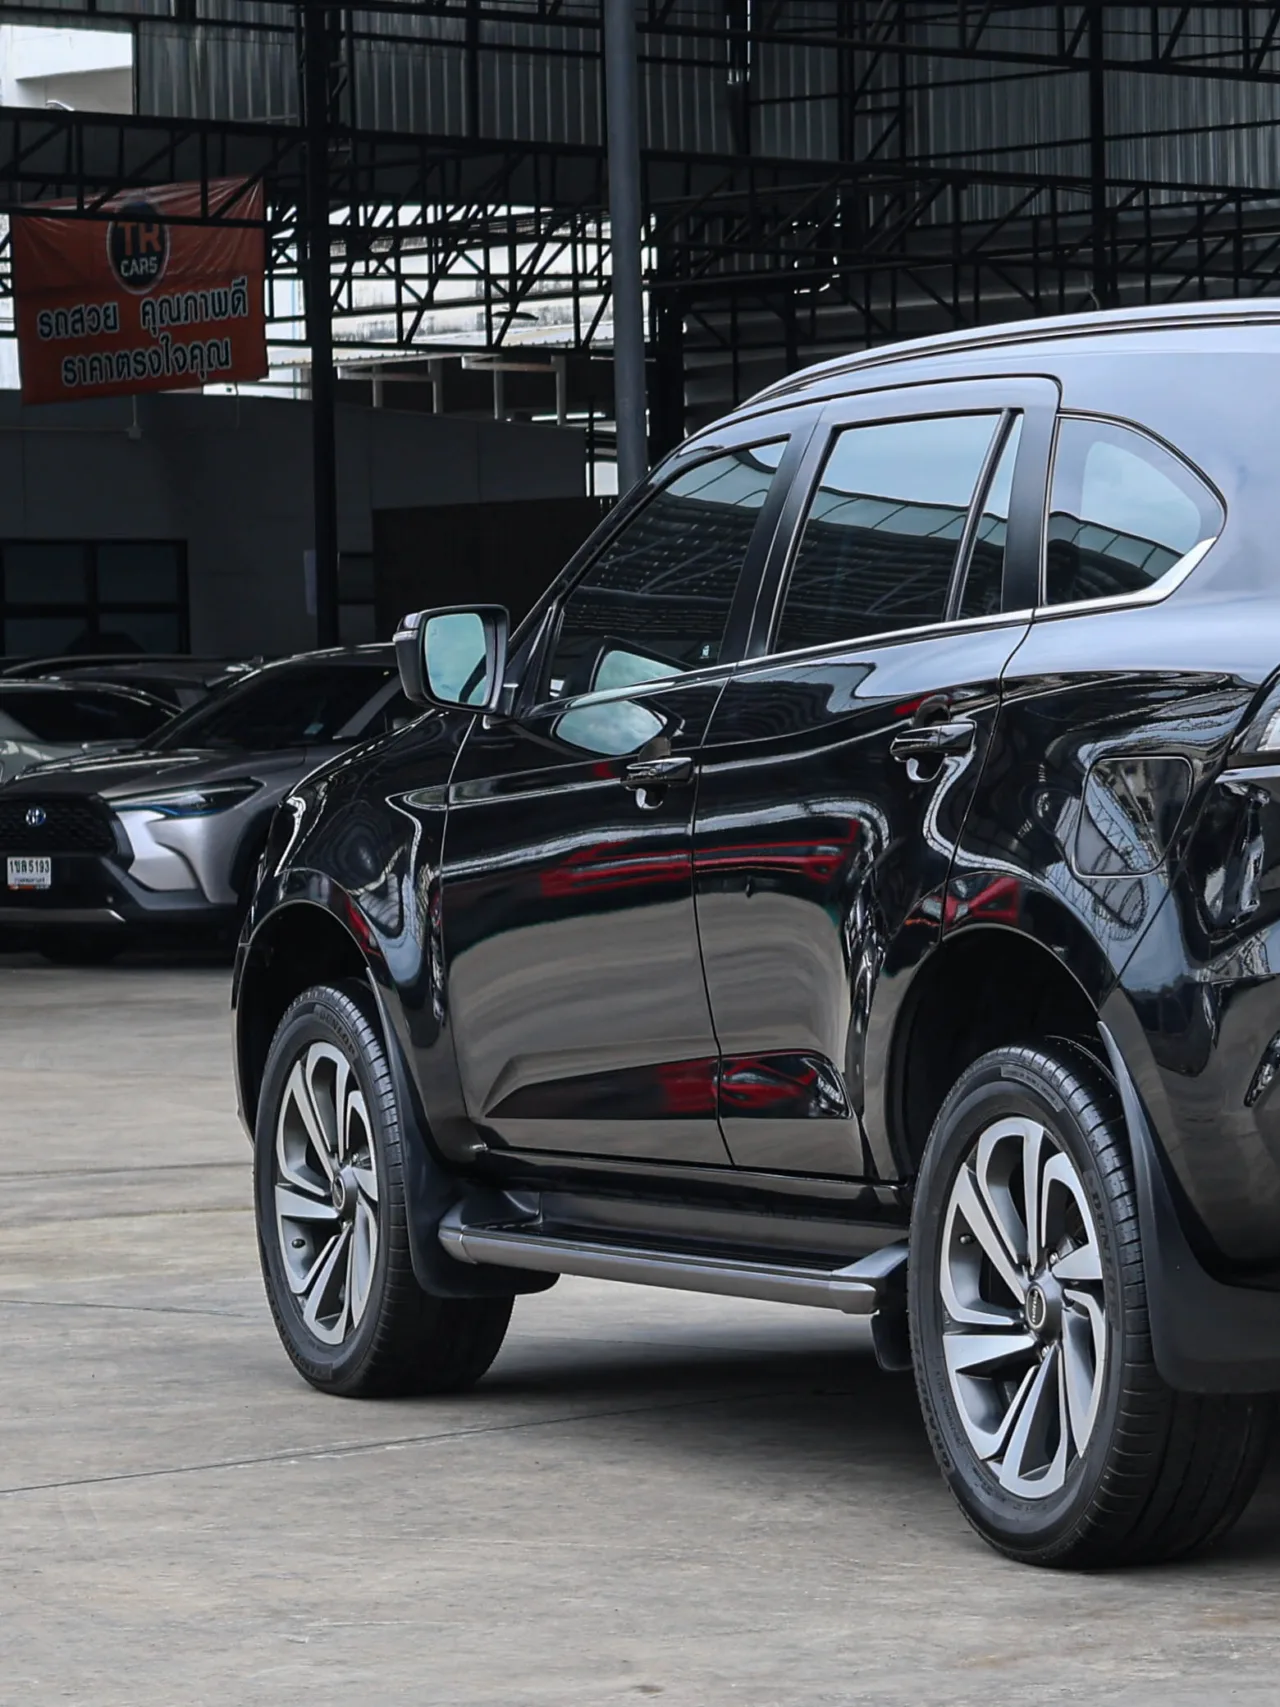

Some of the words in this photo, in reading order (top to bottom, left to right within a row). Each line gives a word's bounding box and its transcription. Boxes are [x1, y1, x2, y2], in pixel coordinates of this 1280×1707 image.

[117, 221, 162, 256] TR
[120, 256, 159, 278] CARS
[38, 302, 119, 340] รถสวย
[140, 276, 249, 337] คุณภาพดี
[62, 333, 232, 387] ราคาตรงใจคุณ
